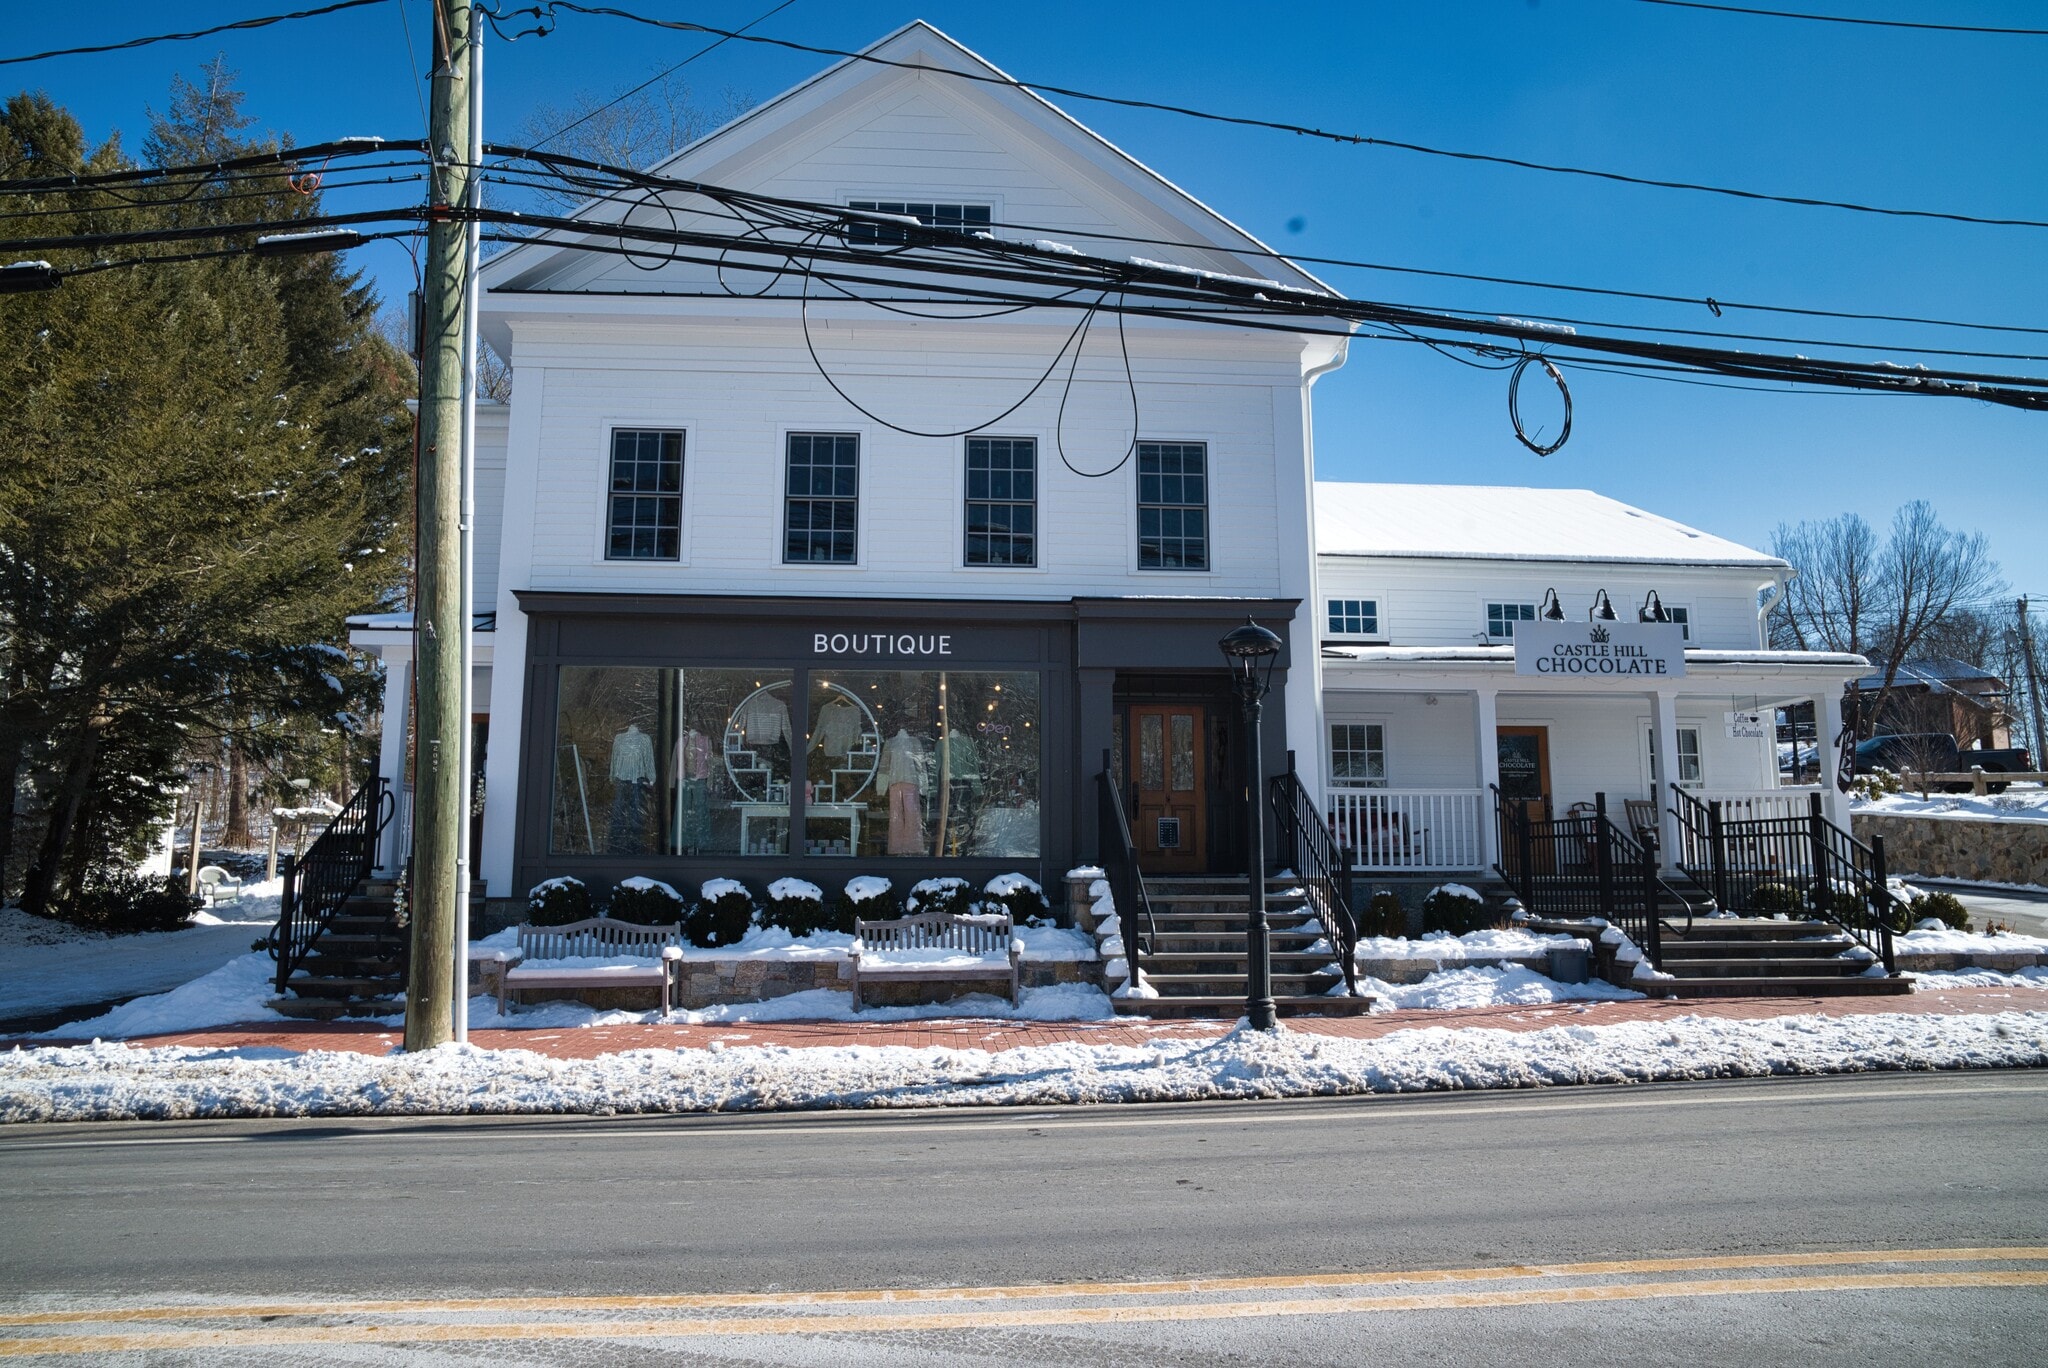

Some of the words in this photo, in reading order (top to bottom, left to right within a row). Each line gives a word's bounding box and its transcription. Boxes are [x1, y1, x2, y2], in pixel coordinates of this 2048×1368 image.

[814, 633, 952, 655] BOUTIQUE
[1553, 644, 1609, 657] CASTLE
[1614, 645, 1648, 658] HILL
[1536, 657, 1667, 674] CHOCOLATE
[1733, 712, 1749, 723] Coffee
[976, 722, 1012, 735] open
[1732, 727, 1741, 737] Hot
[1742, 727, 1763, 737] Chocolate
